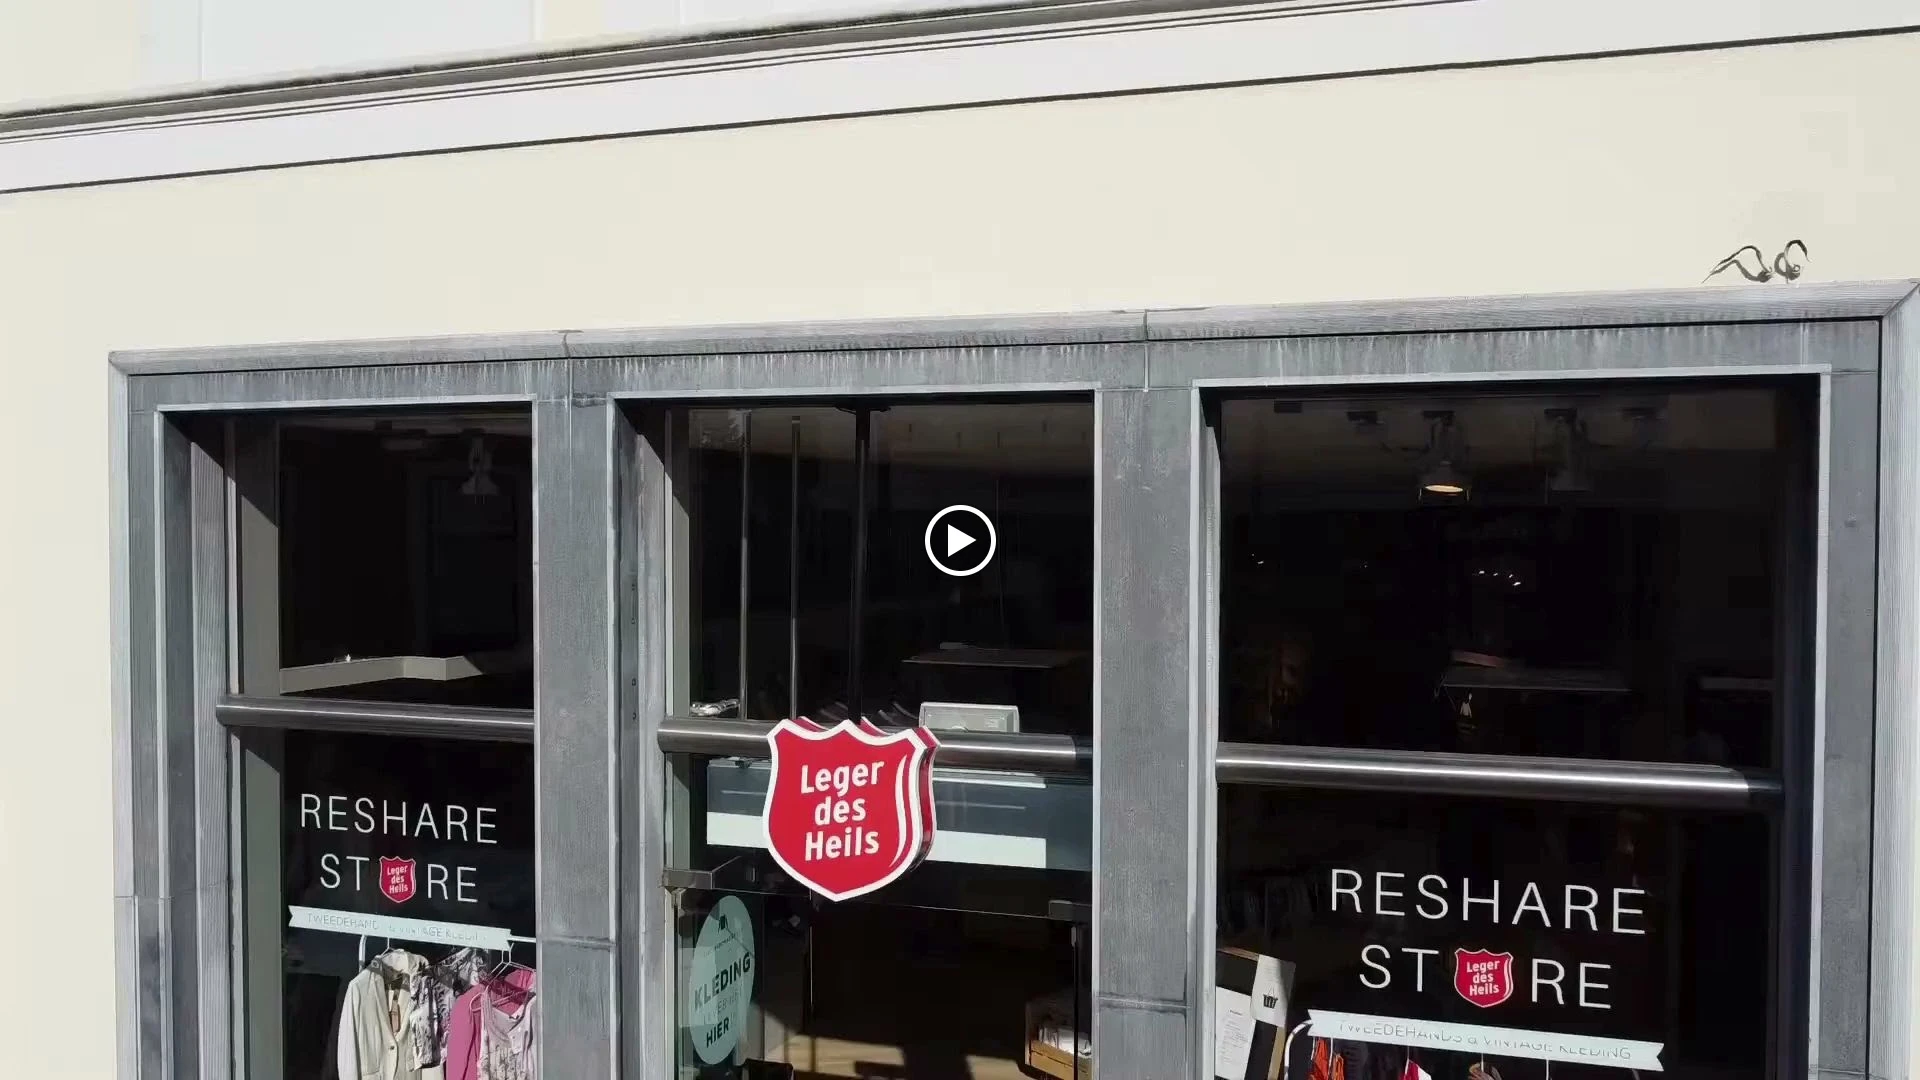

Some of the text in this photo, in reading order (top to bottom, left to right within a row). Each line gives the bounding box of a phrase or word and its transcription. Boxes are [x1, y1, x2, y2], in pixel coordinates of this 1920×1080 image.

[801, 761, 885, 797] Leger
[301, 793, 498, 844] RESHARE
[814, 796, 867, 826] des
[805, 827, 880, 861] Heils
[387, 865, 408, 876] Leger
[391, 875, 405, 885] des
[1331, 868, 1646, 935] RESHARE
[307, 913, 386, 932] TWEEDEHAND
[694, 951, 751, 1011] KLEDING
[1466, 960, 1500, 974] Leger
[1472, 972, 1494, 984] des
[1469, 982, 1500, 996] Heils
[706, 1016, 729, 1048] HIER
